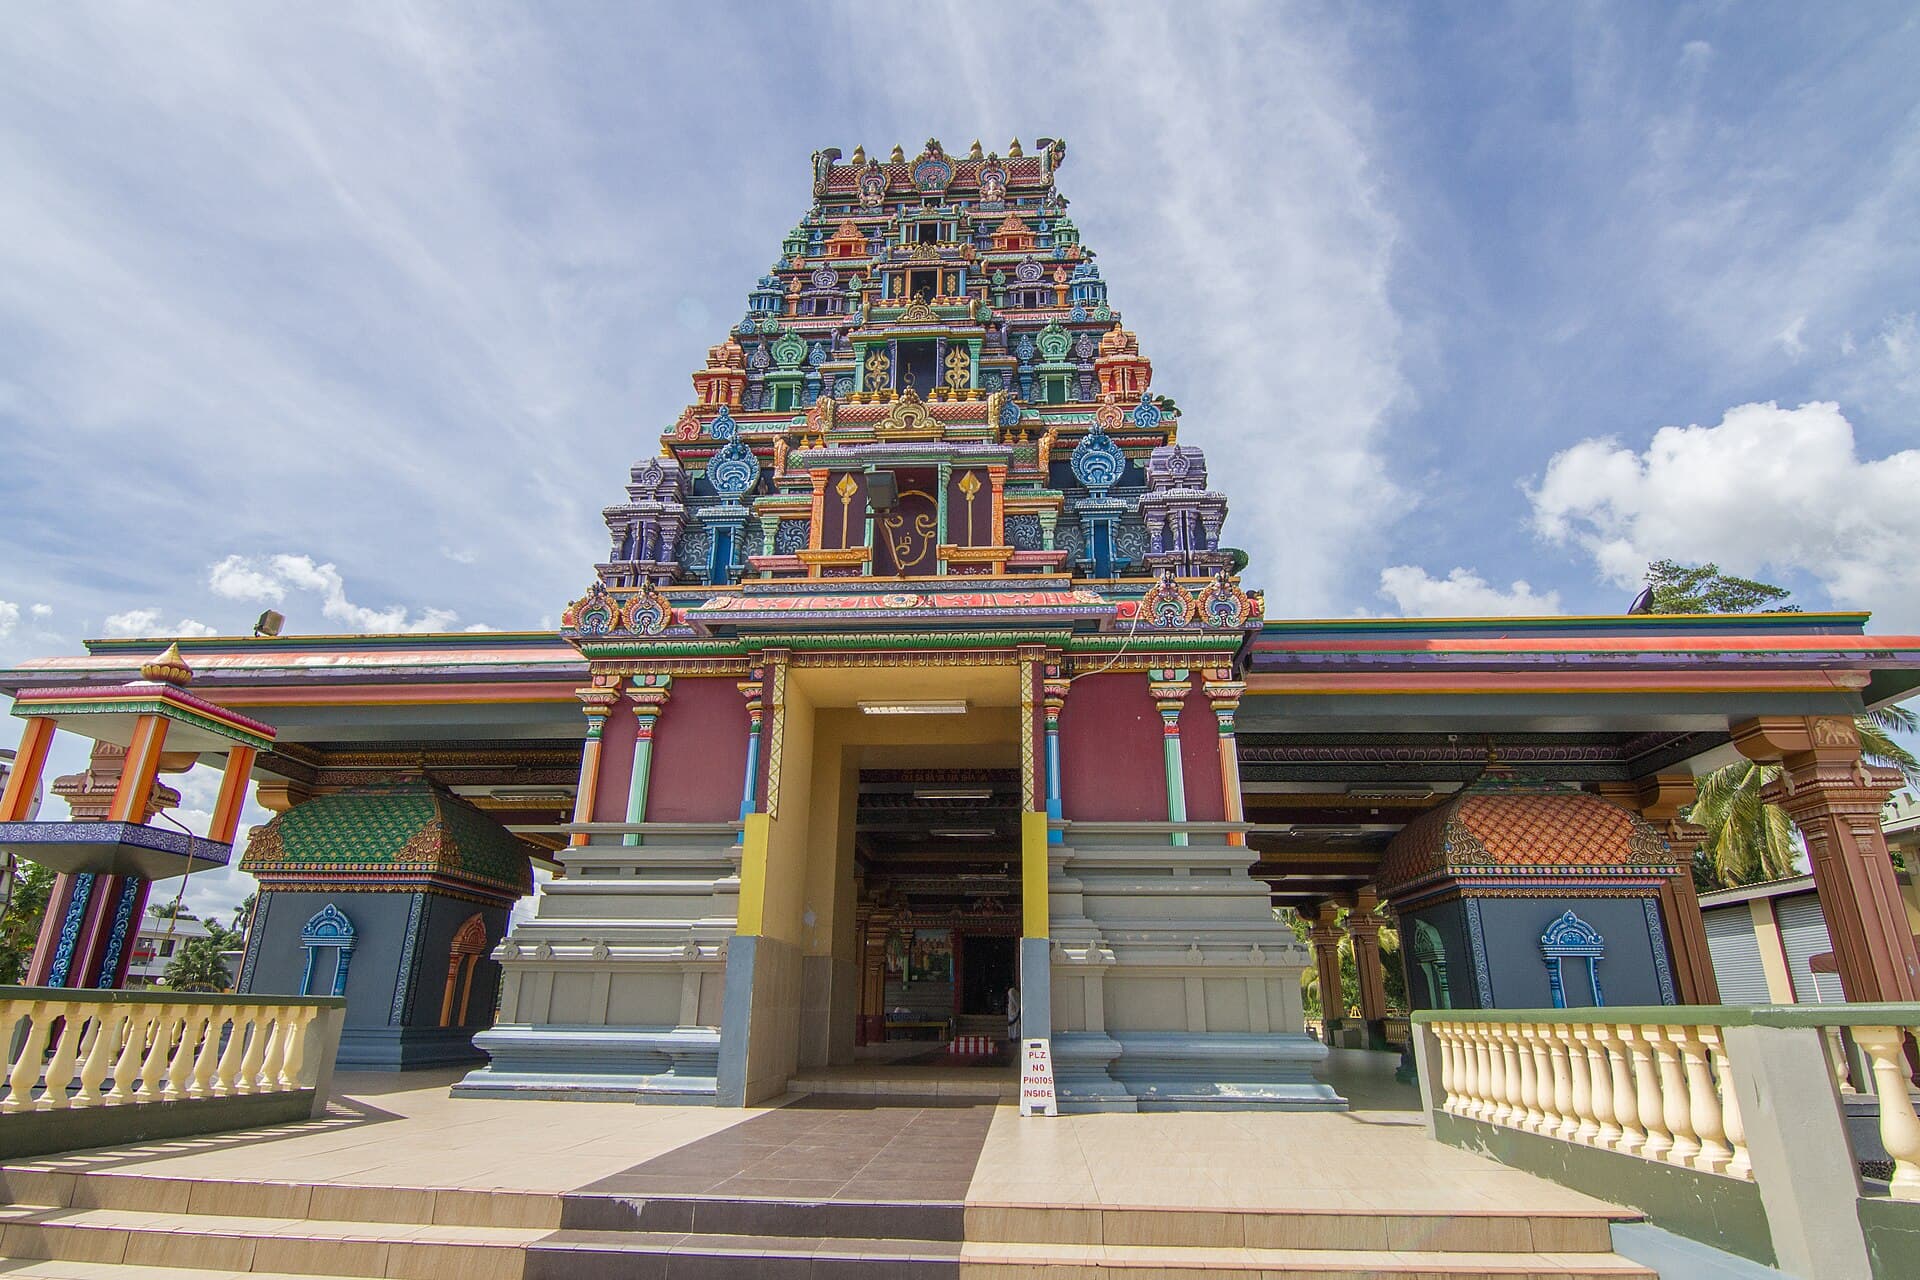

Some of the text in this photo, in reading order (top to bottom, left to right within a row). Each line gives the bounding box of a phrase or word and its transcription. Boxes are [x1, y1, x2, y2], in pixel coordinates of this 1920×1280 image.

[1028, 1051, 1046, 1059] PLZ
[1032, 1063, 1045, 1071] NO
[1023, 1076, 1053, 1084] PHOTOS
[1023, 1089, 1053, 1097] INSIDE
